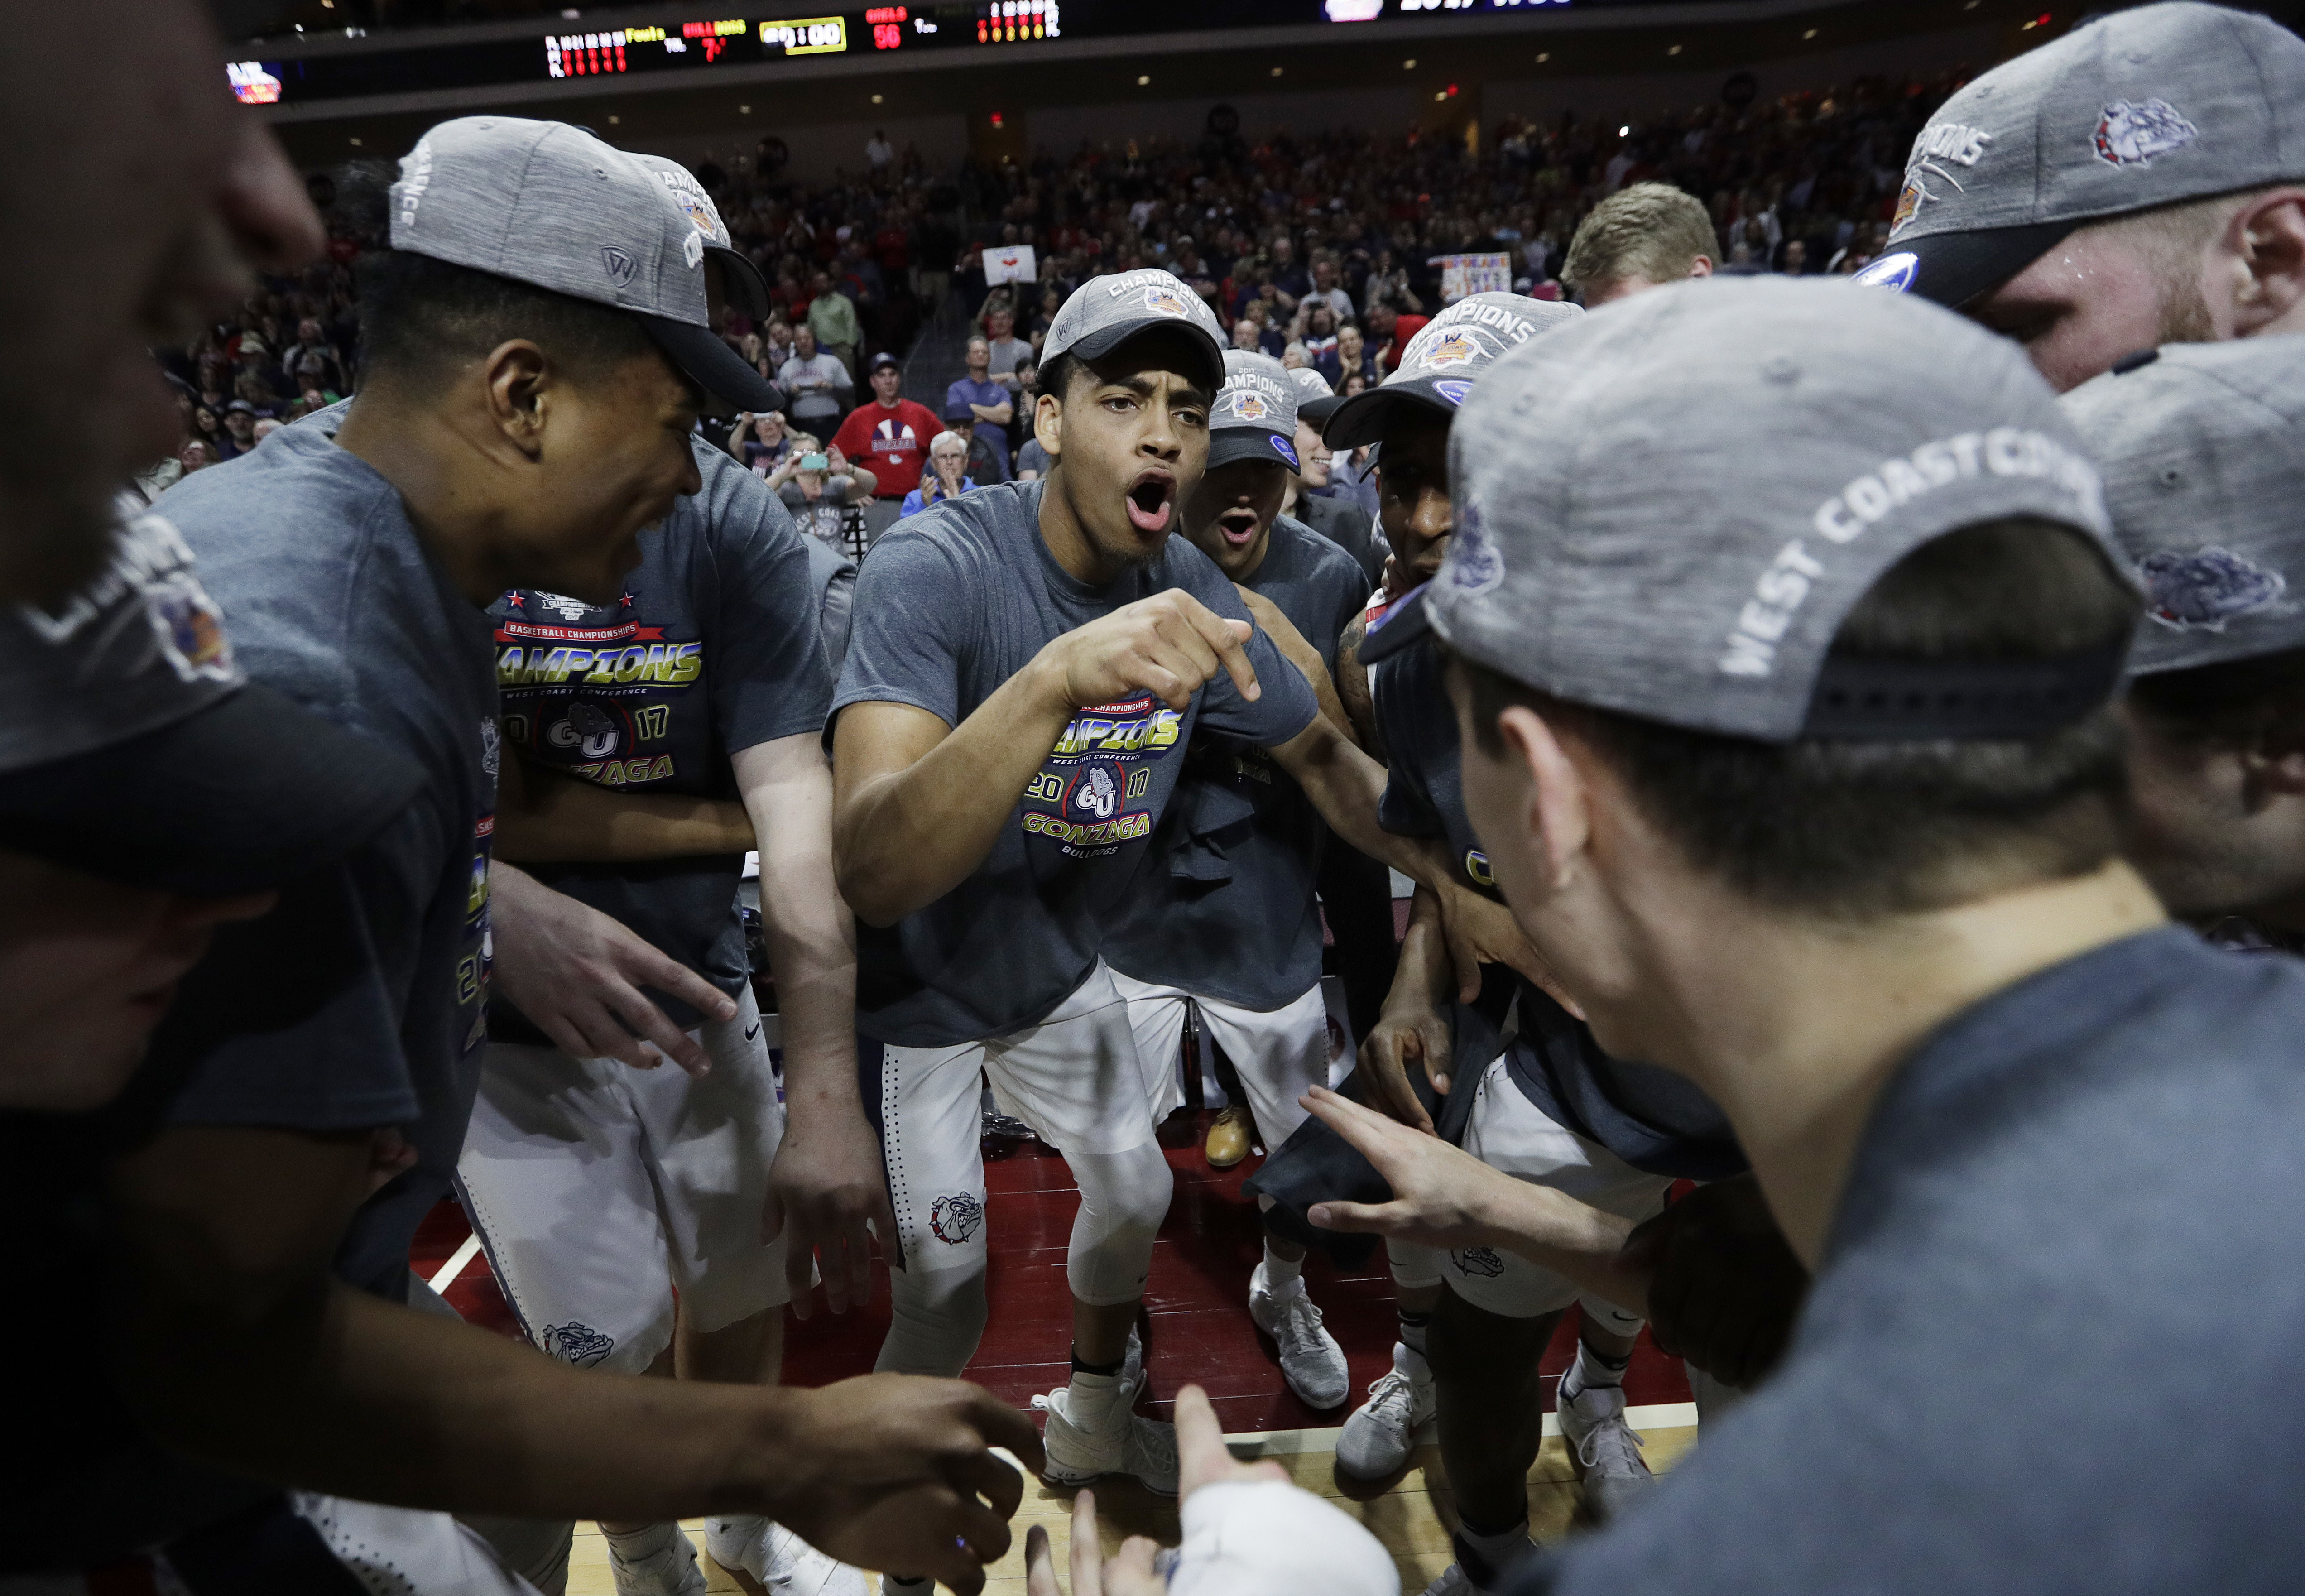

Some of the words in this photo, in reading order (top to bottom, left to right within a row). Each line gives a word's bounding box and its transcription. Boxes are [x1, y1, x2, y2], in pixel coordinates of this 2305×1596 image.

[1109, 273, 1207, 319] CHAMPIONS
[1217, 373, 1285, 403] AMPIONS
[1719, 538, 1825, 678] WEST
[1814, 431, 1983, 543] COAST
[510, 624, 565, 637] BASKETBALL
[567, 624, 636, 639] CHAMPIONSHIPS
[496, 640, 702, 684] AMPIONS
[506, 690, 535, 699] WEST
[579, 688, 648, 697] CONFERENCE
[634, 704, 670, 741] 17
[1126, 767, 1151, 799] 17
[1076, 783, 1117, 819] GU
[1022, 813, 1151, 846] GONZAGA
[1061, 845, 1119, 859] BULLDOGS
